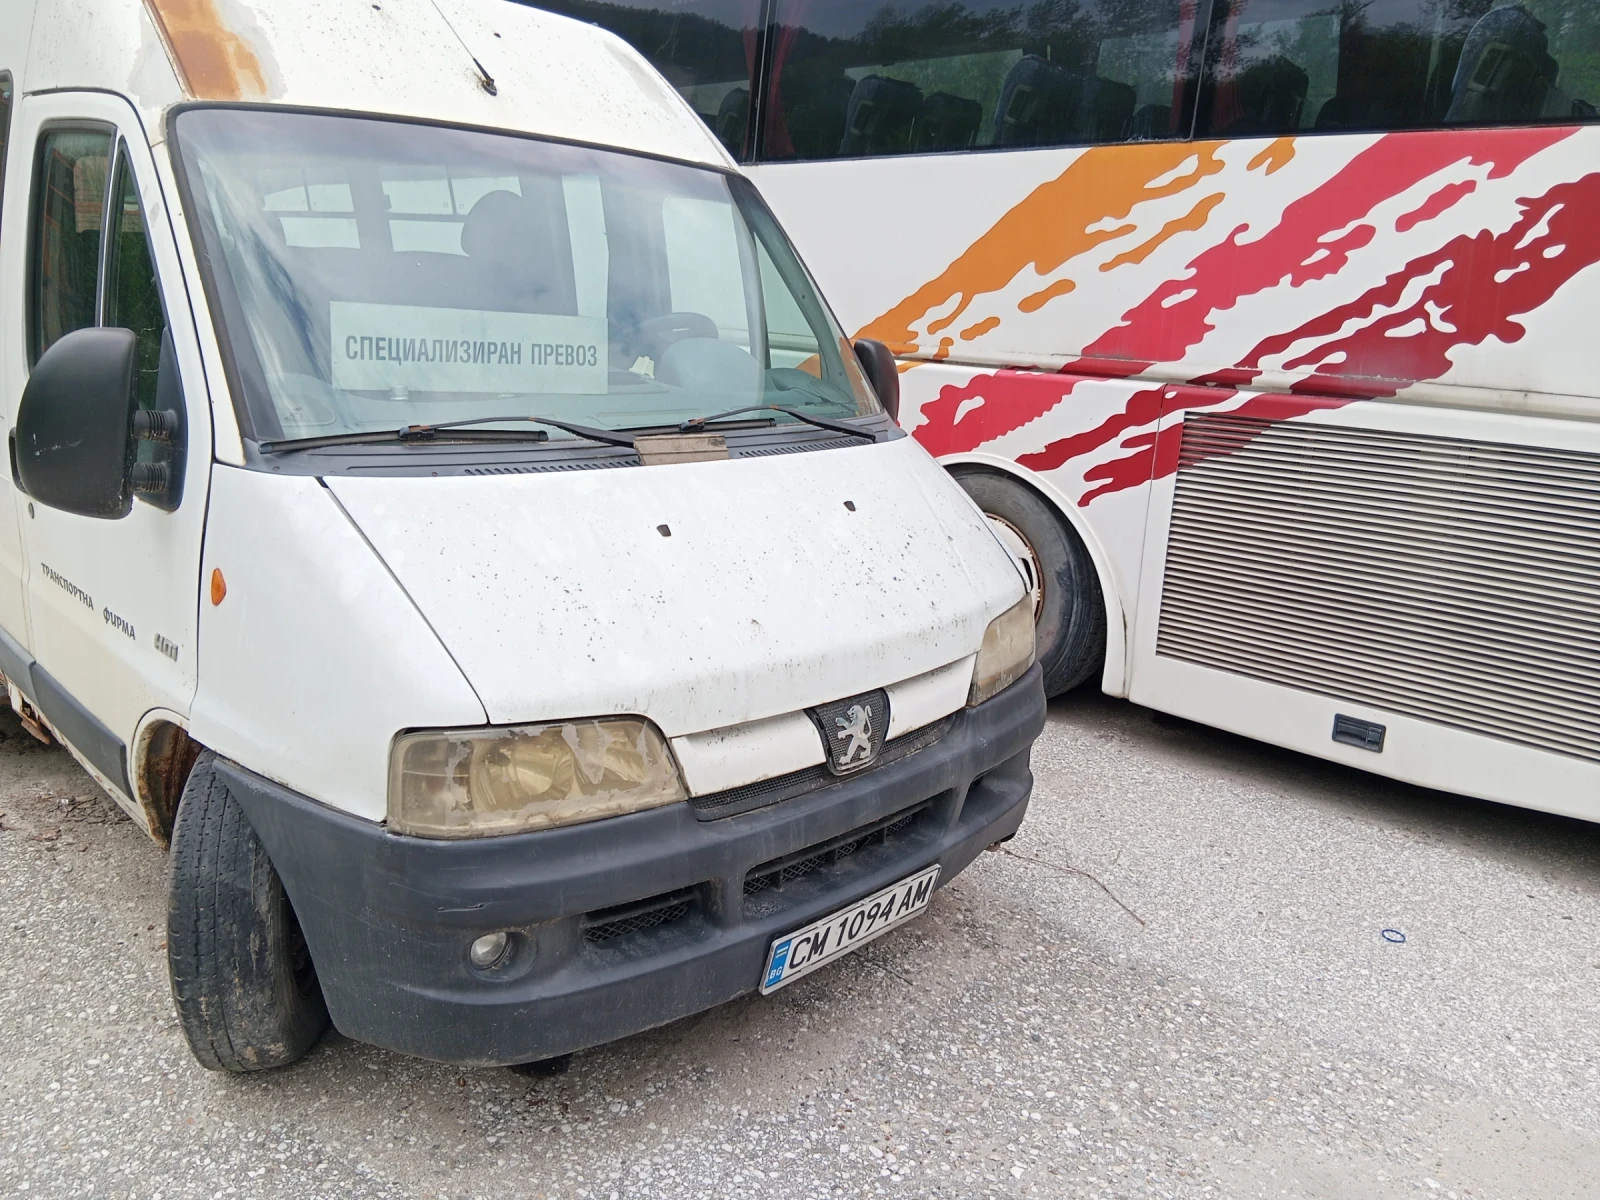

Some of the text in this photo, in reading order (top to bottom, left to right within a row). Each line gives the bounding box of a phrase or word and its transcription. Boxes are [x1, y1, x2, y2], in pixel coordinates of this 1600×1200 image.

[345, 335, 597, 367] СПЕЦИАЛИЗИРАН ПРЕВОЗ
[41, 562, 136, 640] ТРАНСПОРТНА ФИРМА
[789, 875, 933, 969] CM 1094 AM
[769, 966, 783, 980] BG
